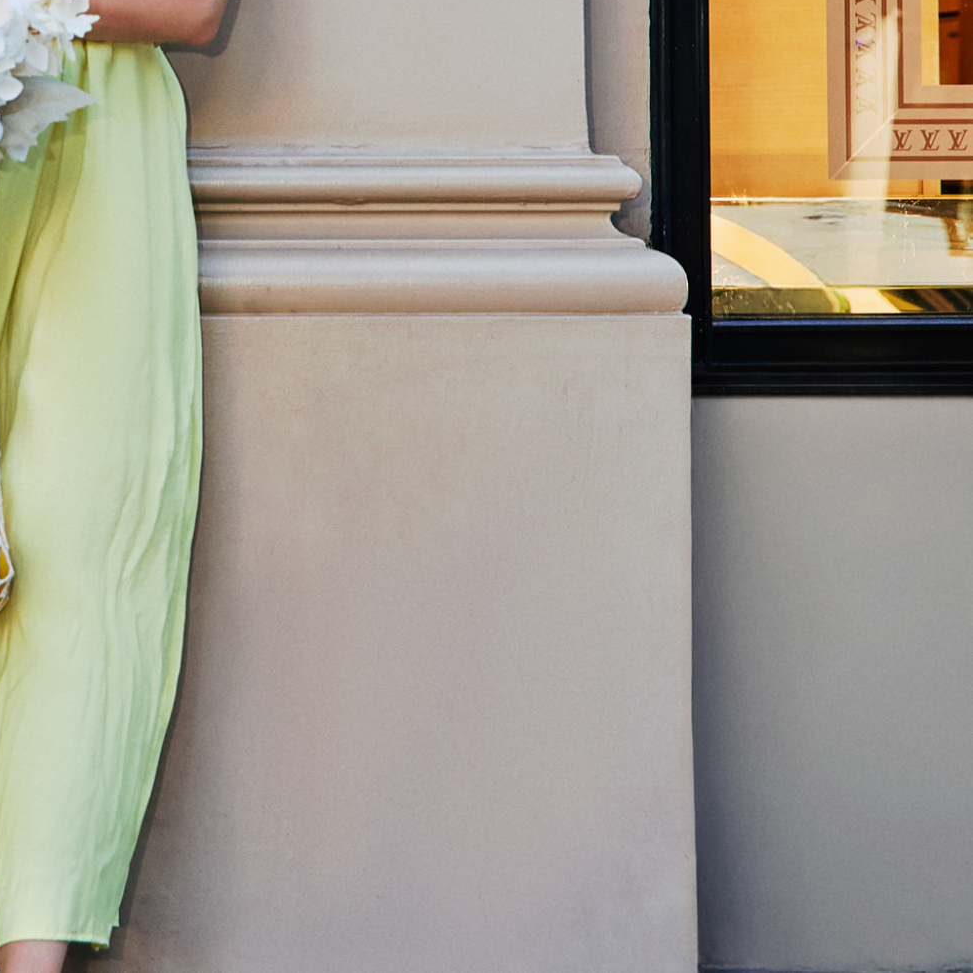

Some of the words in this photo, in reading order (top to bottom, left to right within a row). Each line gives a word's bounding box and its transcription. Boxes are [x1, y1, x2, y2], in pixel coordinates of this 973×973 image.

[855, 12, 876, 32] LV
[892, 130, 913, 151] LV
[920, 130, 941, 151] LV
[948, 130, 969, 151] LV
